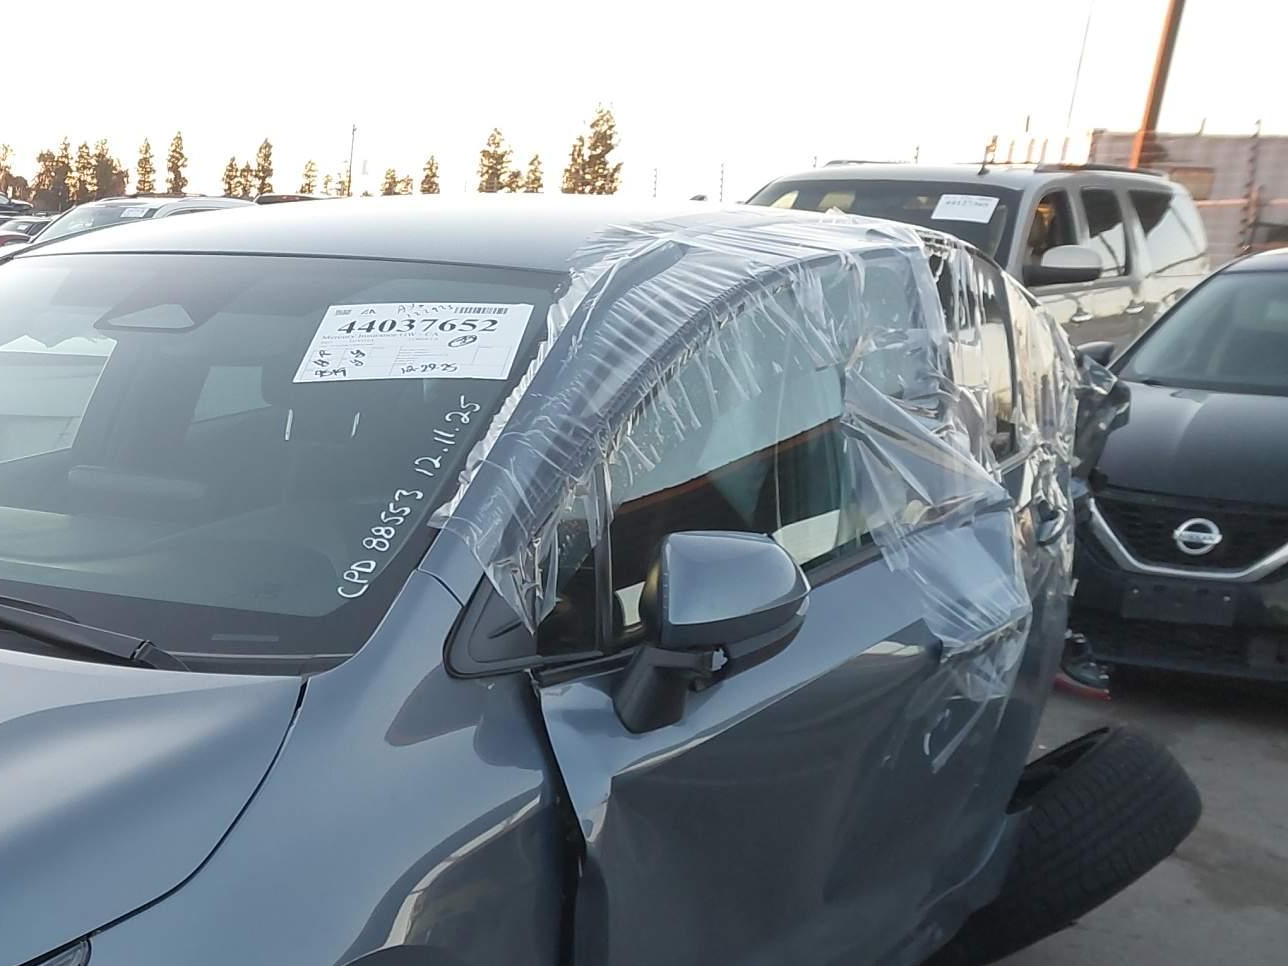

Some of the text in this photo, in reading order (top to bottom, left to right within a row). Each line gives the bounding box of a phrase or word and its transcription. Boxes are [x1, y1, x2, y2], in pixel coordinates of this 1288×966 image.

[337, 318, 498, 334] 44037652
[337, 559, 377, 598] CPD
[362, 488, 424, 552] 88553
